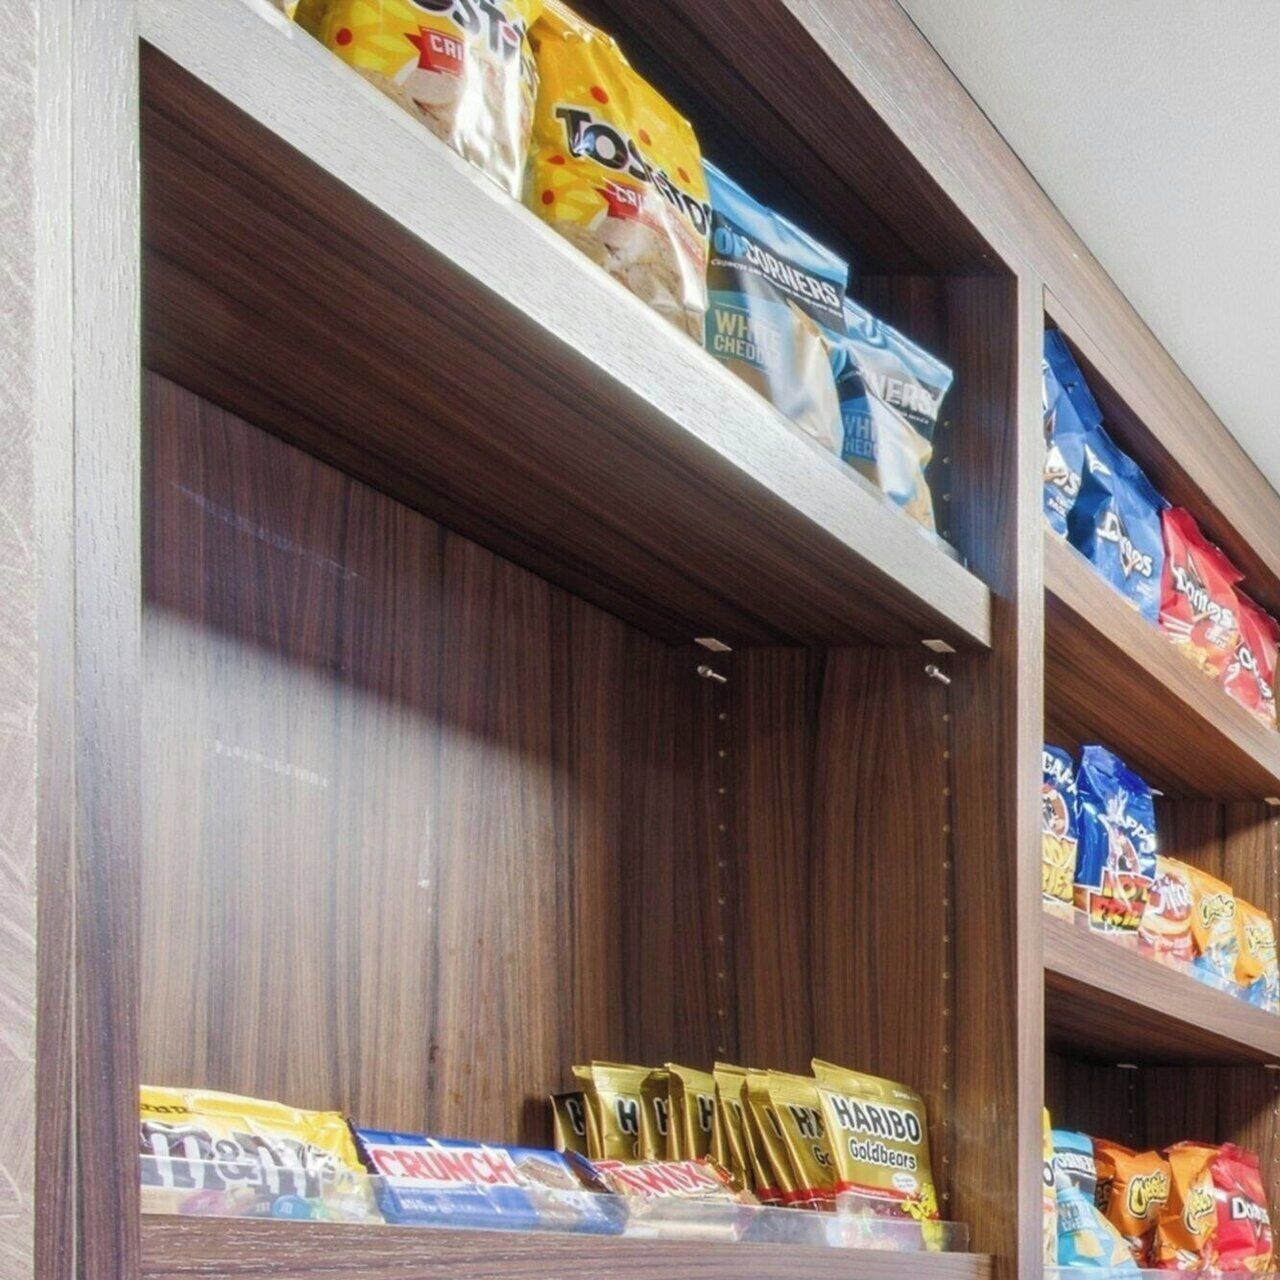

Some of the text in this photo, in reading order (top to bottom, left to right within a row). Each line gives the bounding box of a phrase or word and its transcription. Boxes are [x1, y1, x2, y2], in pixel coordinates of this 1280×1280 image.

[830, 1096, 921, 1144] HARIBO
[371, 1147, 519, 1187] CRUNCH
[849, 1138, 917, 1171] Goldbears
